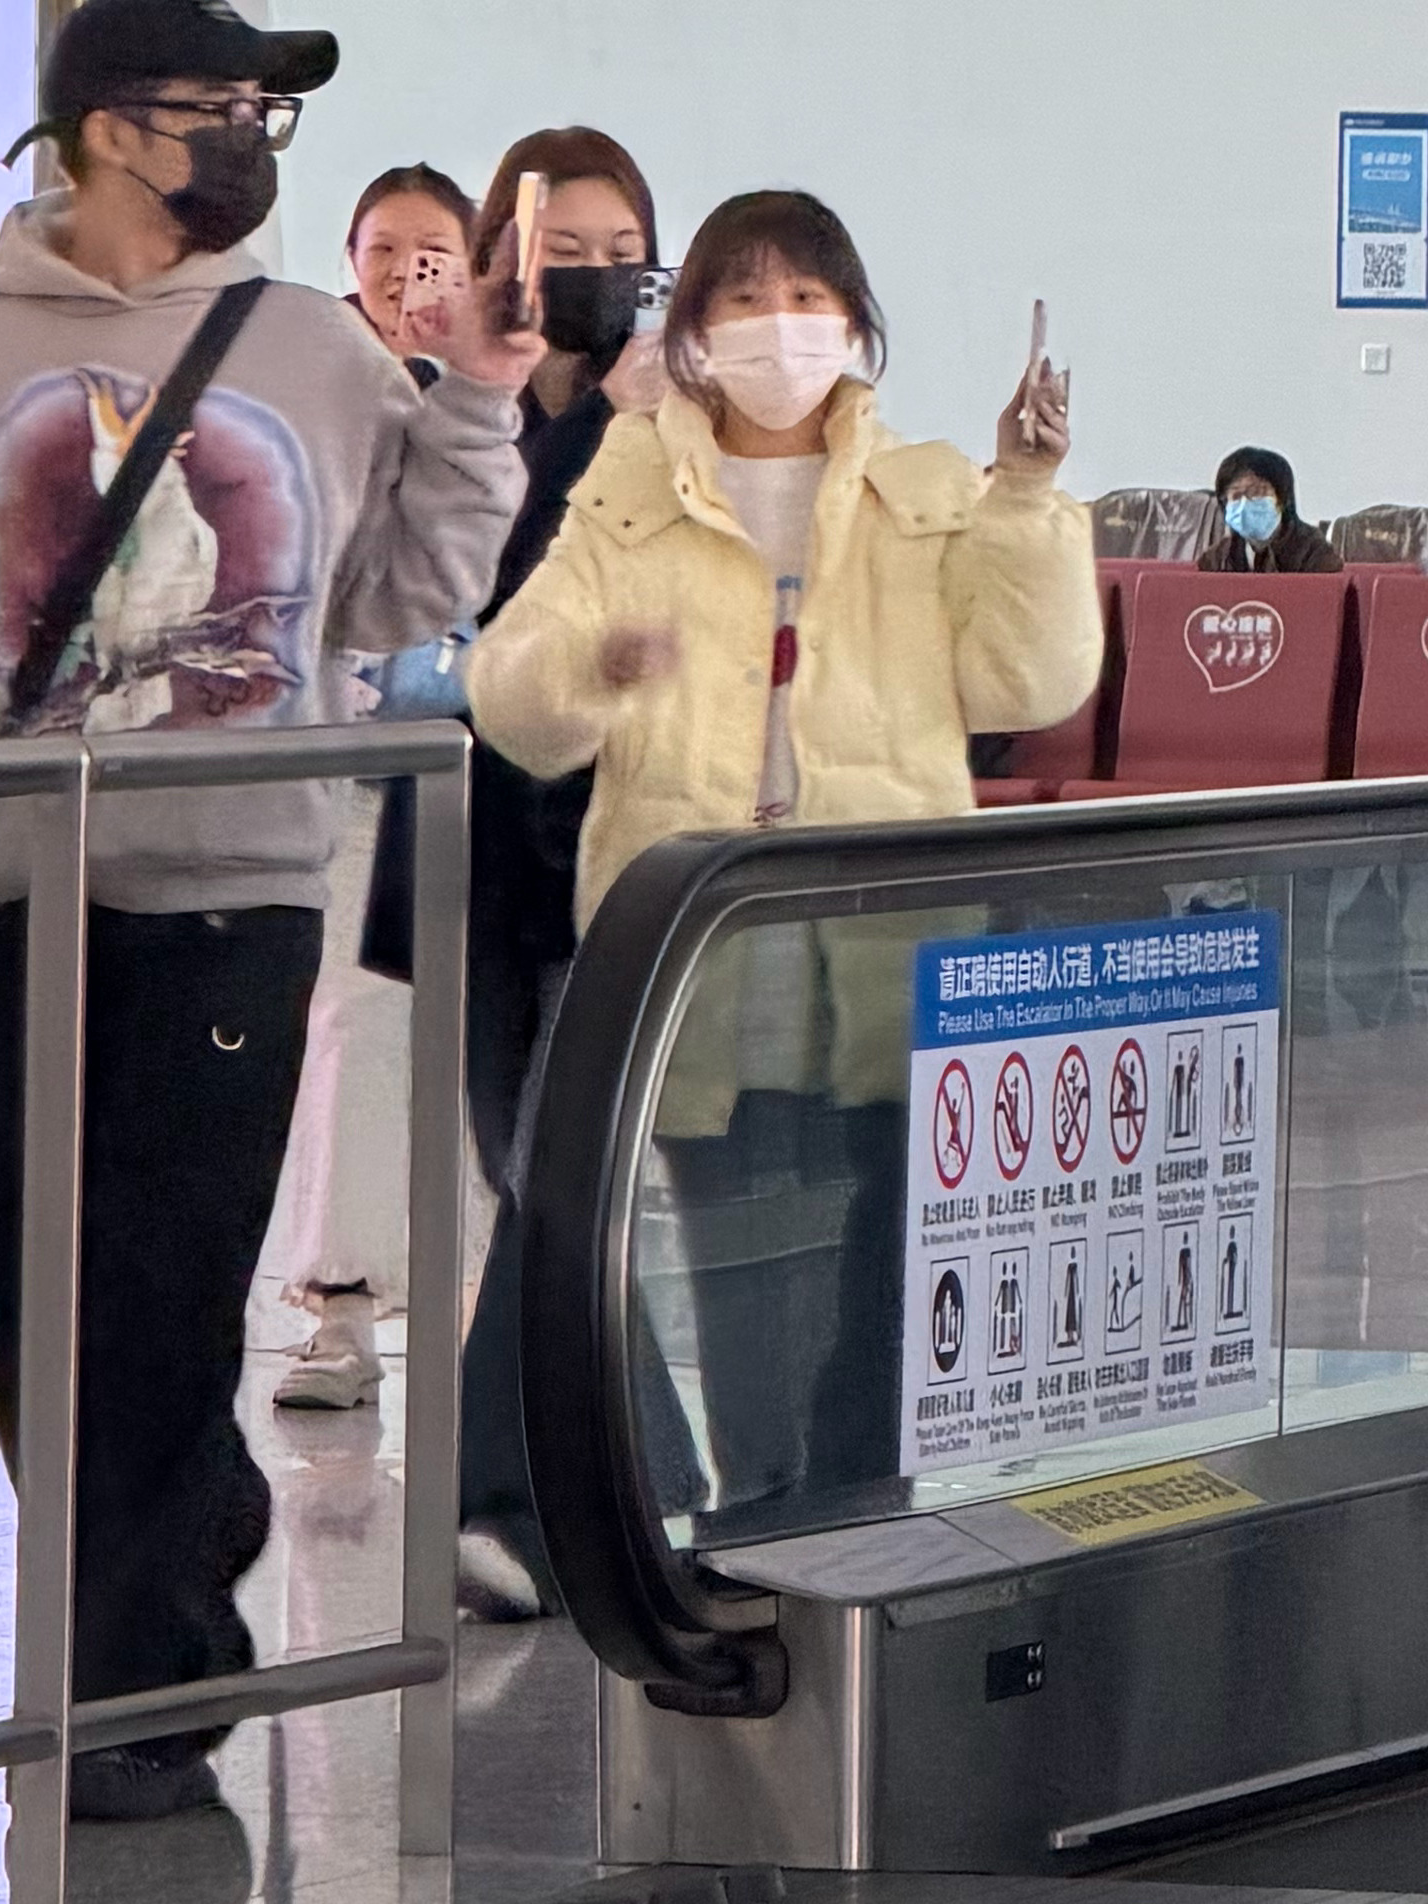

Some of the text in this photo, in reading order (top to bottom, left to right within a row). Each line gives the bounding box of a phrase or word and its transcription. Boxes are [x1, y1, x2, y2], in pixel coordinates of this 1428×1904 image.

[938, 1011, 972, 1034] Please
[974, 1008, 994, 1031] Use
[996, 1004, 1014, 1028] The
[1074, 996, 1092, 1018] The
[1095, 994, 1127, 1022] Proper
[1192, 983, 1221, 1007] Cause
